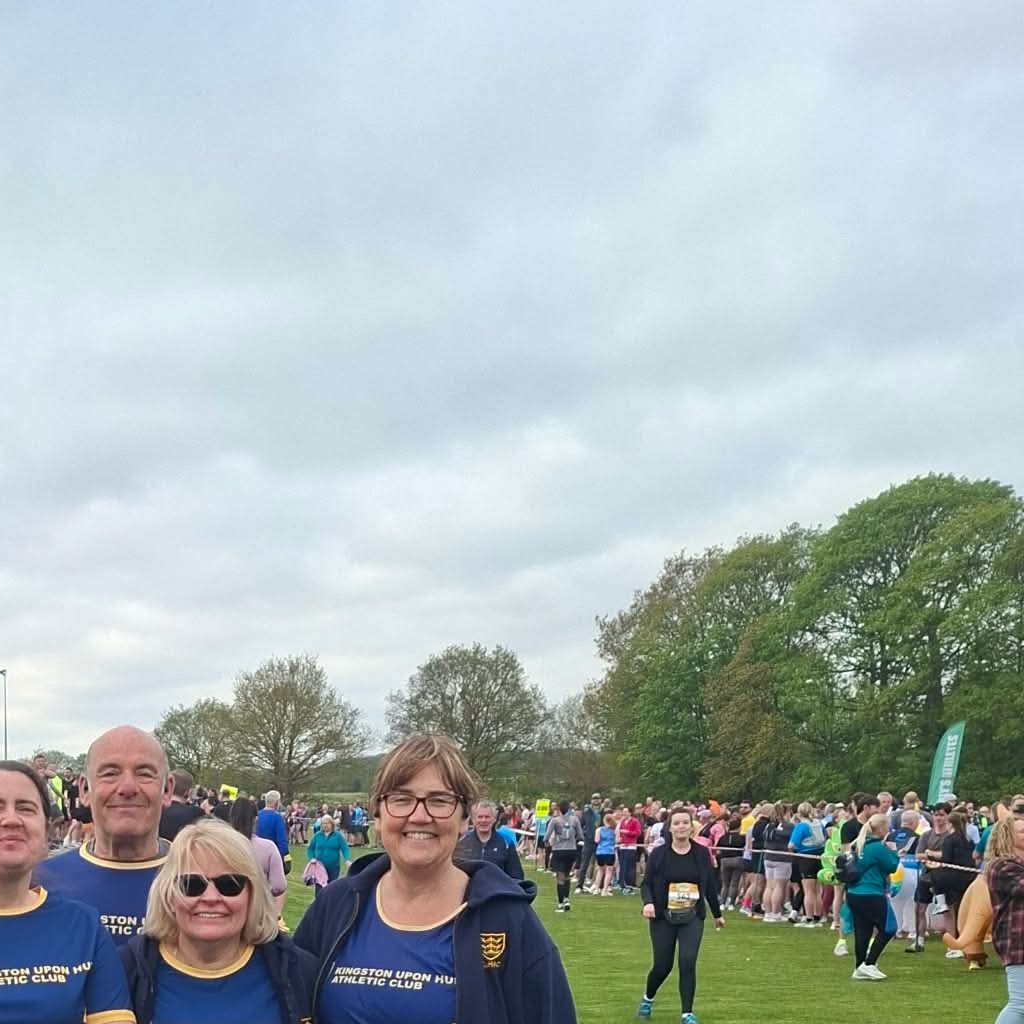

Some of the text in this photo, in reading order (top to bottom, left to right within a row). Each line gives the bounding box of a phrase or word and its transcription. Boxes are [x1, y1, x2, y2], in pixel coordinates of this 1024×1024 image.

[100, 914, 138, 926] STON
[33, 965, 70, 975] UPON
[72, 961, 93, 974] HU
[31, 974, 66, 983] CLUB
[331, 975, 423, 990] ATHLETIC CLUB
[335, 966, 457, 985] KINGSTON UPON HU
